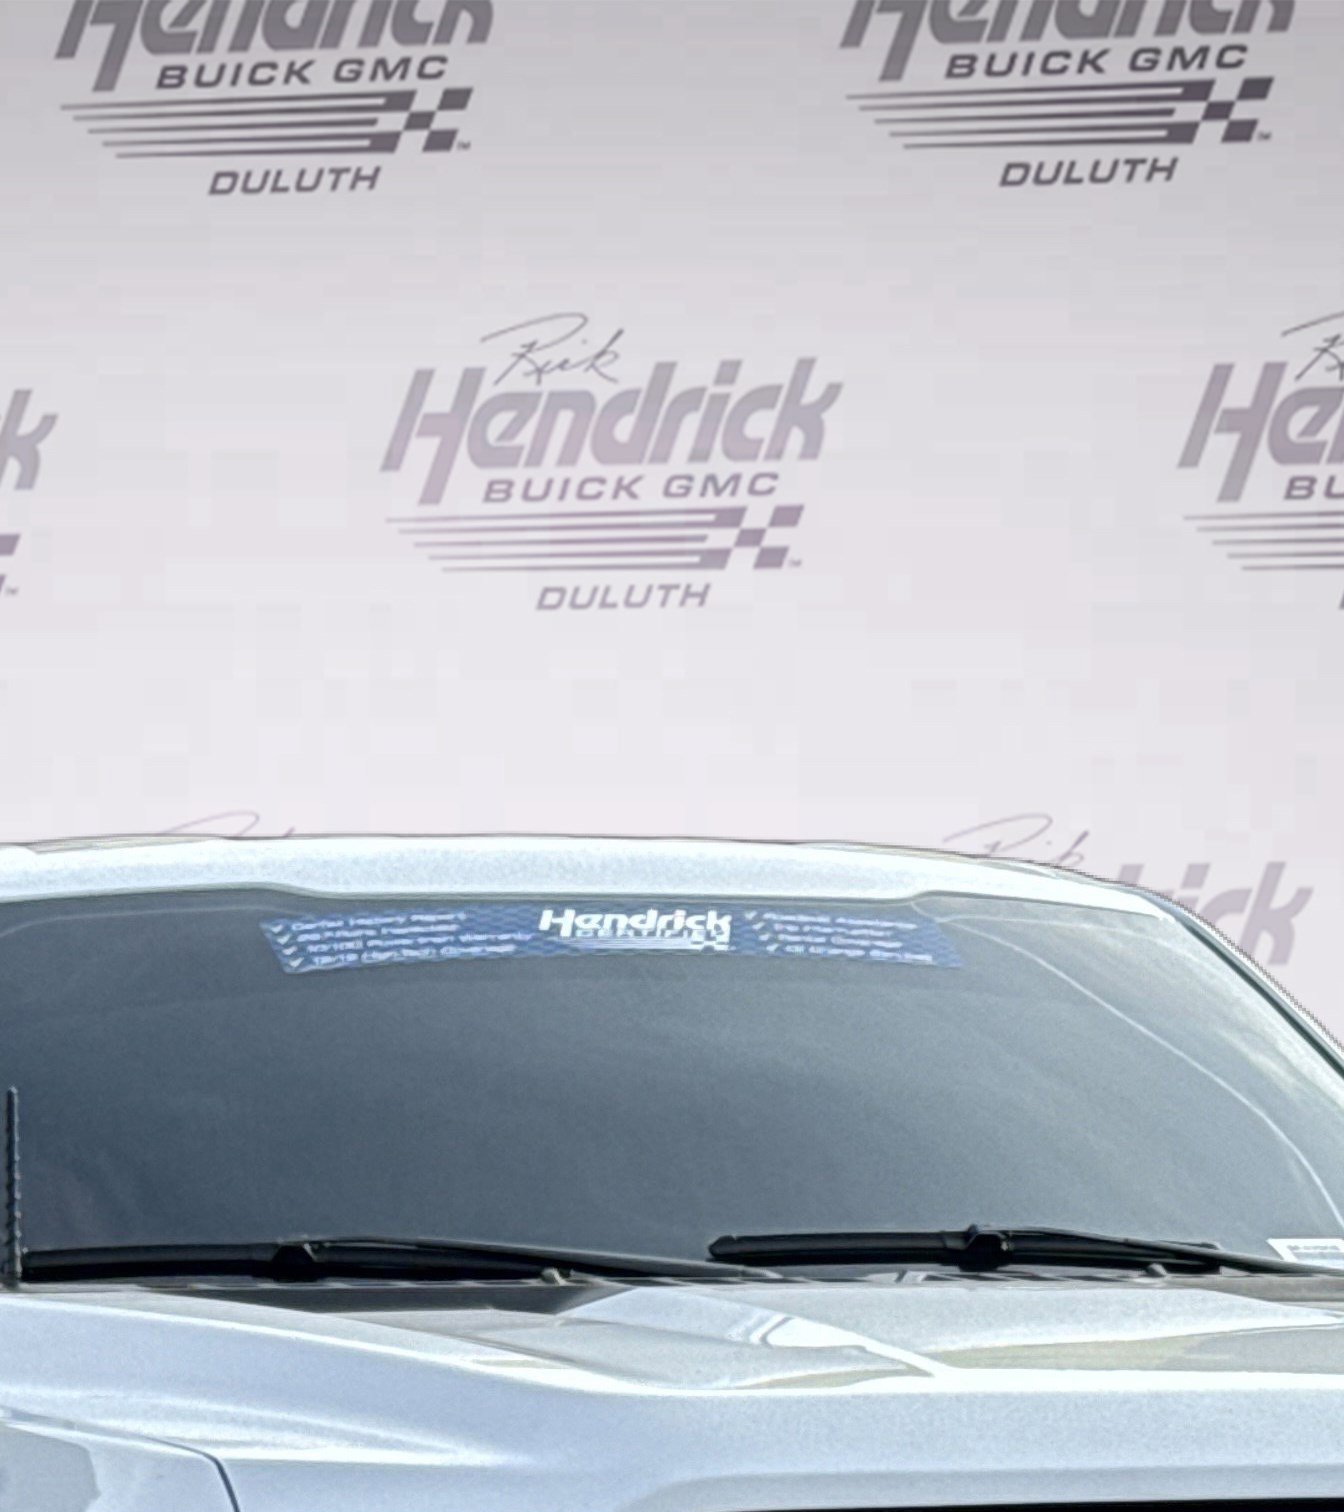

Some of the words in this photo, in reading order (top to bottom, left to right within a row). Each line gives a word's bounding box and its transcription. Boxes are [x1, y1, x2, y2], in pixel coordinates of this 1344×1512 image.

[156, 60, 314, 89] BUICK
[333, 56, 448, 83] GMC
[945, 49, 1109, 79] BUICK
[1129, 44, 1248, 72] GMC
[209, 166, 381, 195] DULUTH
[1000, 157, 1178, 187] DULUTH
[380, 357, 843, 505] Hendrick
[483, 475, 643, 503] BUICK
[663, 472, 779, 498] GMC
[536, 583, 711, 610] DULUTH
[538, 908, 732, 938] Hendrick
